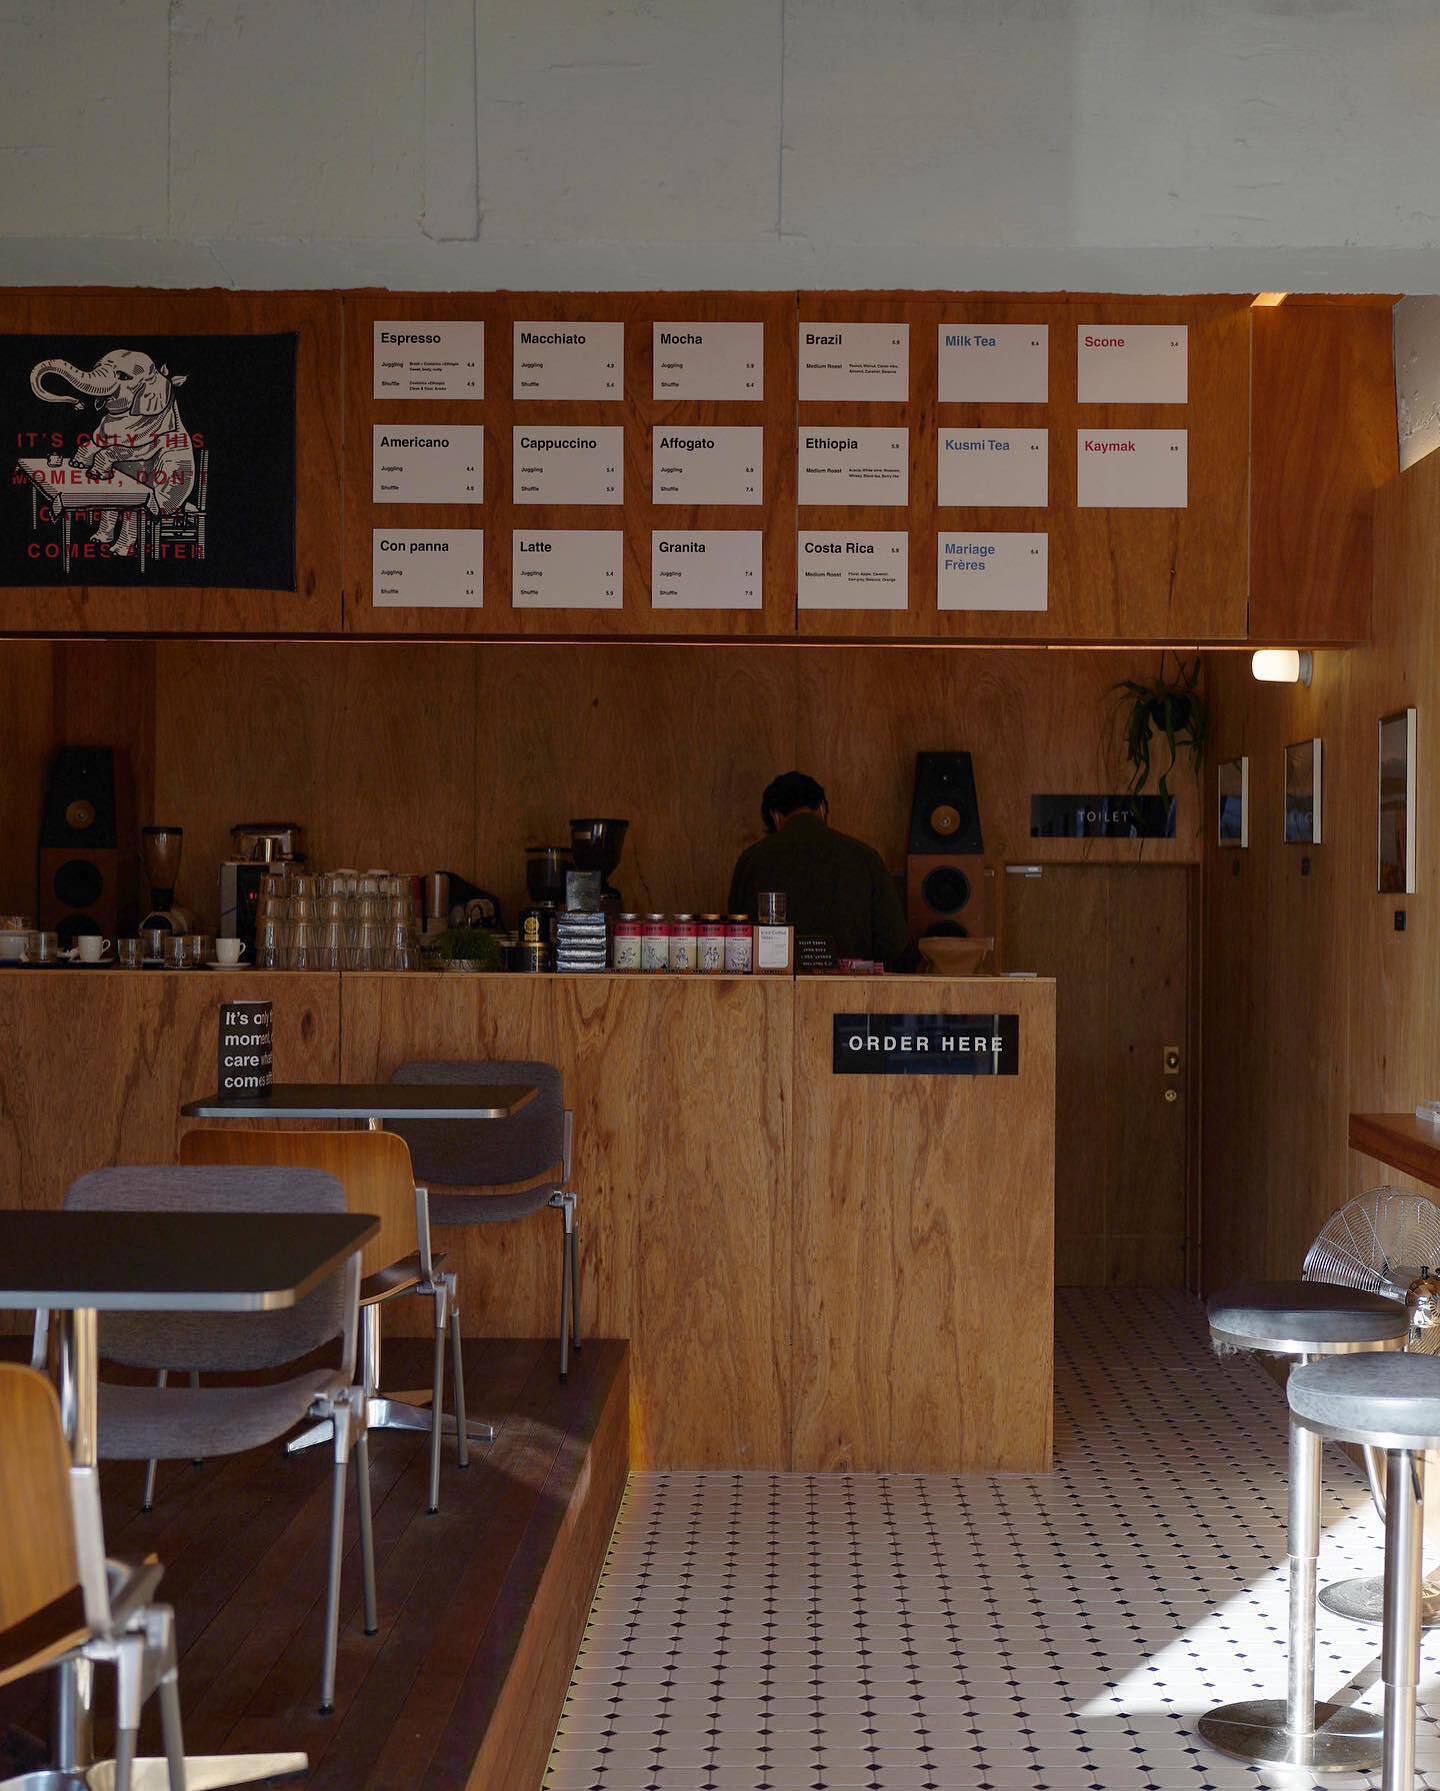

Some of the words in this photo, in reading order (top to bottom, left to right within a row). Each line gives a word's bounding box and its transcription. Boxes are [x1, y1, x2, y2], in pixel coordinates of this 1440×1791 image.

[381, 332, 442, 347] Espresso
[520, 332, 586, 345] Macchiato
[660, 333, 703, 345] Mocha
[805, 333, 842, 345] Brazil
[945, 335, 972, 347] Milk
[974, 335, 996, 347] Tea
[1084, 335, 1125, 348] Scone
[381, 361, 404, 369] Juggling
[16, 432, 64, 449] IT'S
[380, 436, 450, 448] Americano
[520, 437, 597, 452] Cappuccino
[659, 437, 715, 452] Affogato
[805, 437, 858, 452] Ethiopia
[945, 439, 985, 451] Kusmi
[987, 439, 1010, 451] Tea
[1084, 440, 1136, 455] Kaymak
[380, 465, 404, 473] Juggling
[520, 466, 544, 474] Juggling
[380, 539, 406, 552] Con
[409, 539, 449, 555] panna
[520, 540, 552, 553] Latte
[658, 541, 706, 553] Granita
[804, 542, 842, 554] Costa
[845, 542, 875, 554] Rica
[944, 543, 996, 558] Mariage
[944, 556, 987, 571] Frères
[1078, 810, 1129, 823] TOILET
[225, 1011, 249, 1026] It's
[848, 1035, 929, 1052] ORDER
[942, 1036, 1004, 1052] HERE
[224, 1055, 260, 1067] care
